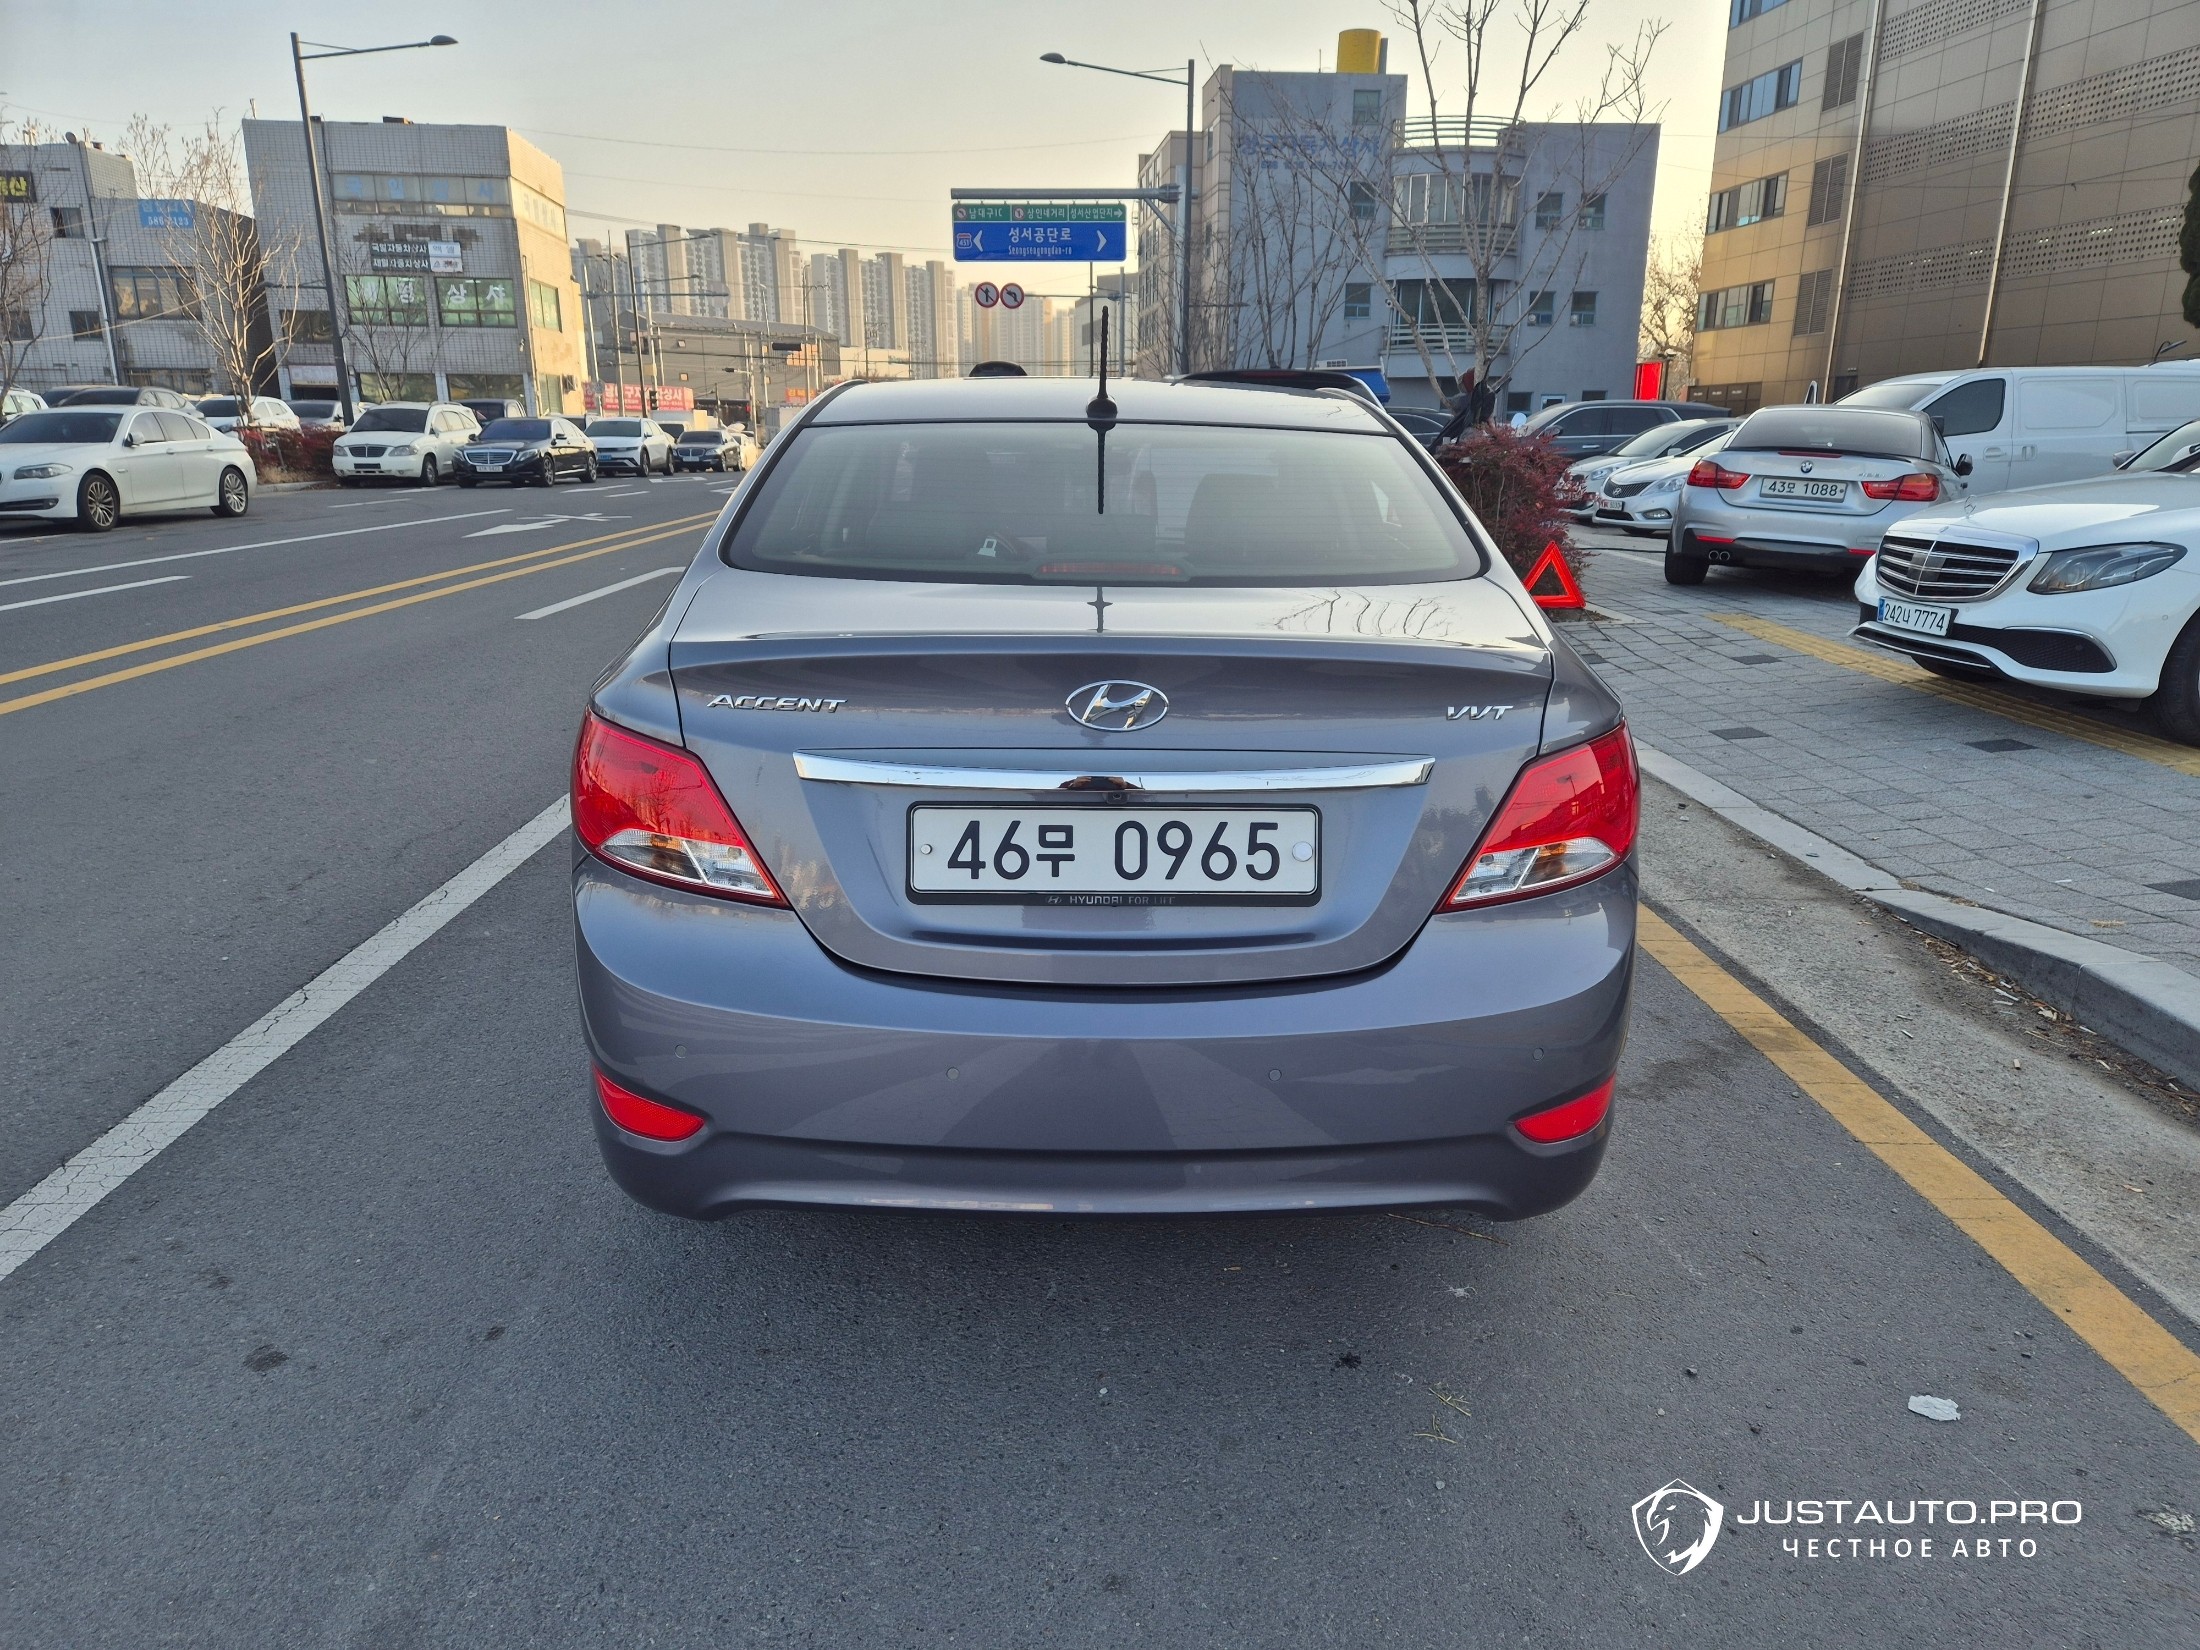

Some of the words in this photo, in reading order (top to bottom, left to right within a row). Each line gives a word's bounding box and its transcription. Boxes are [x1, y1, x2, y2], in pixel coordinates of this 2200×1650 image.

[969, 208, 1003, 219] 남대구IC
[1027, 208, 1065, 219] 상인네거리
[1070, 208, 1113, 219] 성서산업단지
[1008, 227, 1072, 243] 성서공단로
[1008, 246, 1072, 257] Seongseogongdan-ro
[1768, 480, 1796, 494] 43모
[1803, 482, 1838, 496] 1088
[1884, 603, 1911, 624] 242나
[1914, 608, 1945, 631] 7774
[706, 694, 848, 713] ACCENT
[1446, 705, 1514, 720] VVT
[947, 820, 1075, 880] 46무
[1114, 820, 1280, 881] 0965
[1069, 895, 1122, 905] HYUNDAI
[1128, 896, 1149, 905] FOR
